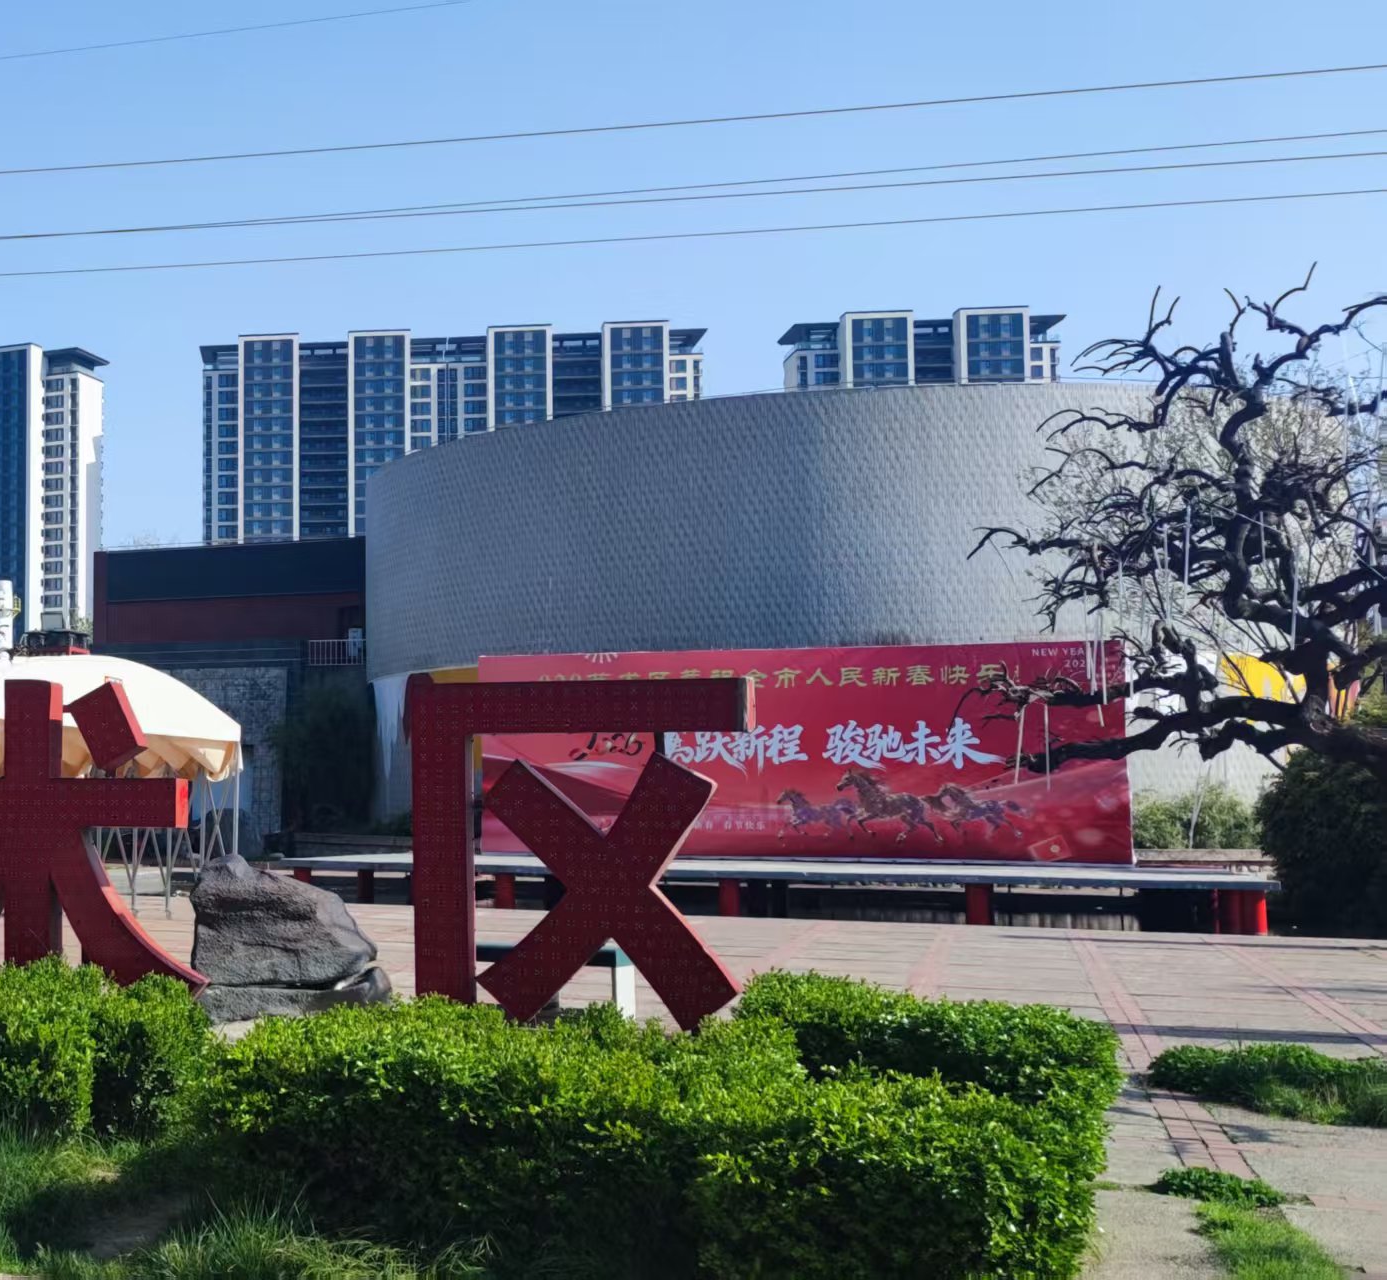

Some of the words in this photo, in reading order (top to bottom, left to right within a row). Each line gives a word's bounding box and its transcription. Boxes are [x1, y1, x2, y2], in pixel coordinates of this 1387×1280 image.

[1031, 647, 1058, 657] NEW
[1062, 646, 1091, 657] YEA
[1064, 659, 1091, 668] 202
[822, 716, 1007, 771] 骏驰未来
